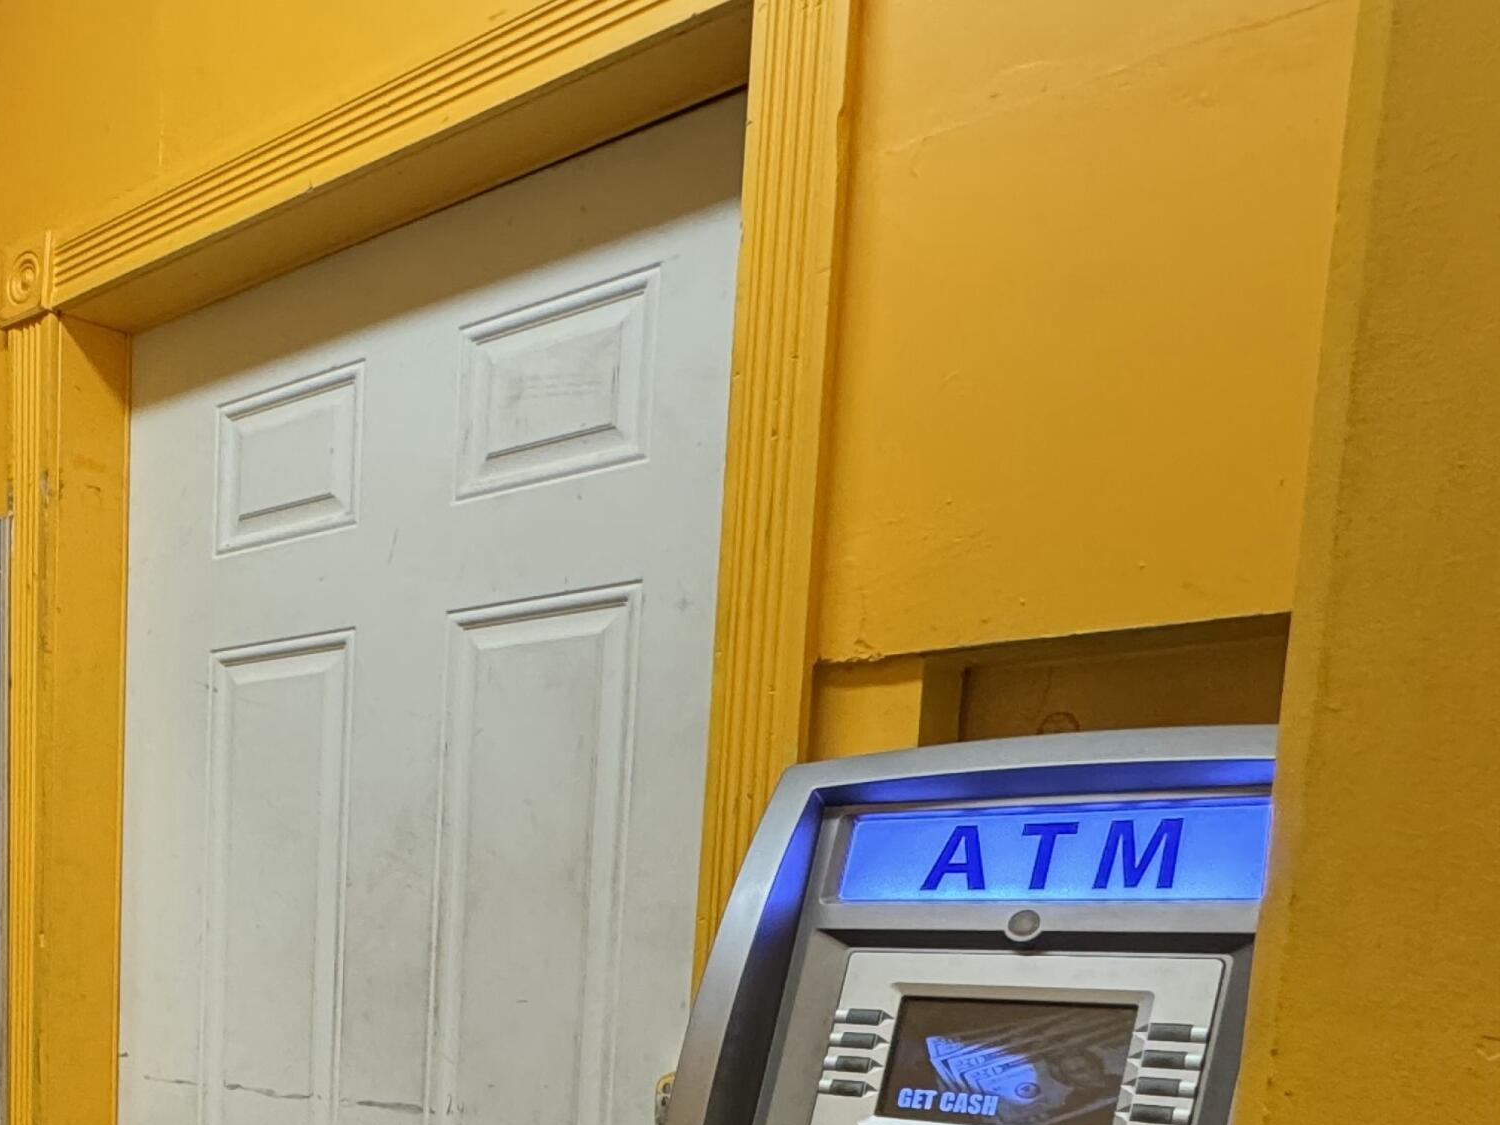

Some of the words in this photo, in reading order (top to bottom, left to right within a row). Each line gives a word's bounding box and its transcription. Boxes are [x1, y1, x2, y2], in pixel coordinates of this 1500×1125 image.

[920, 818, 1185, 891] ATM
[897, 1087, 938, 1111] GET
[939, 1091, 999, 1117] CASH
